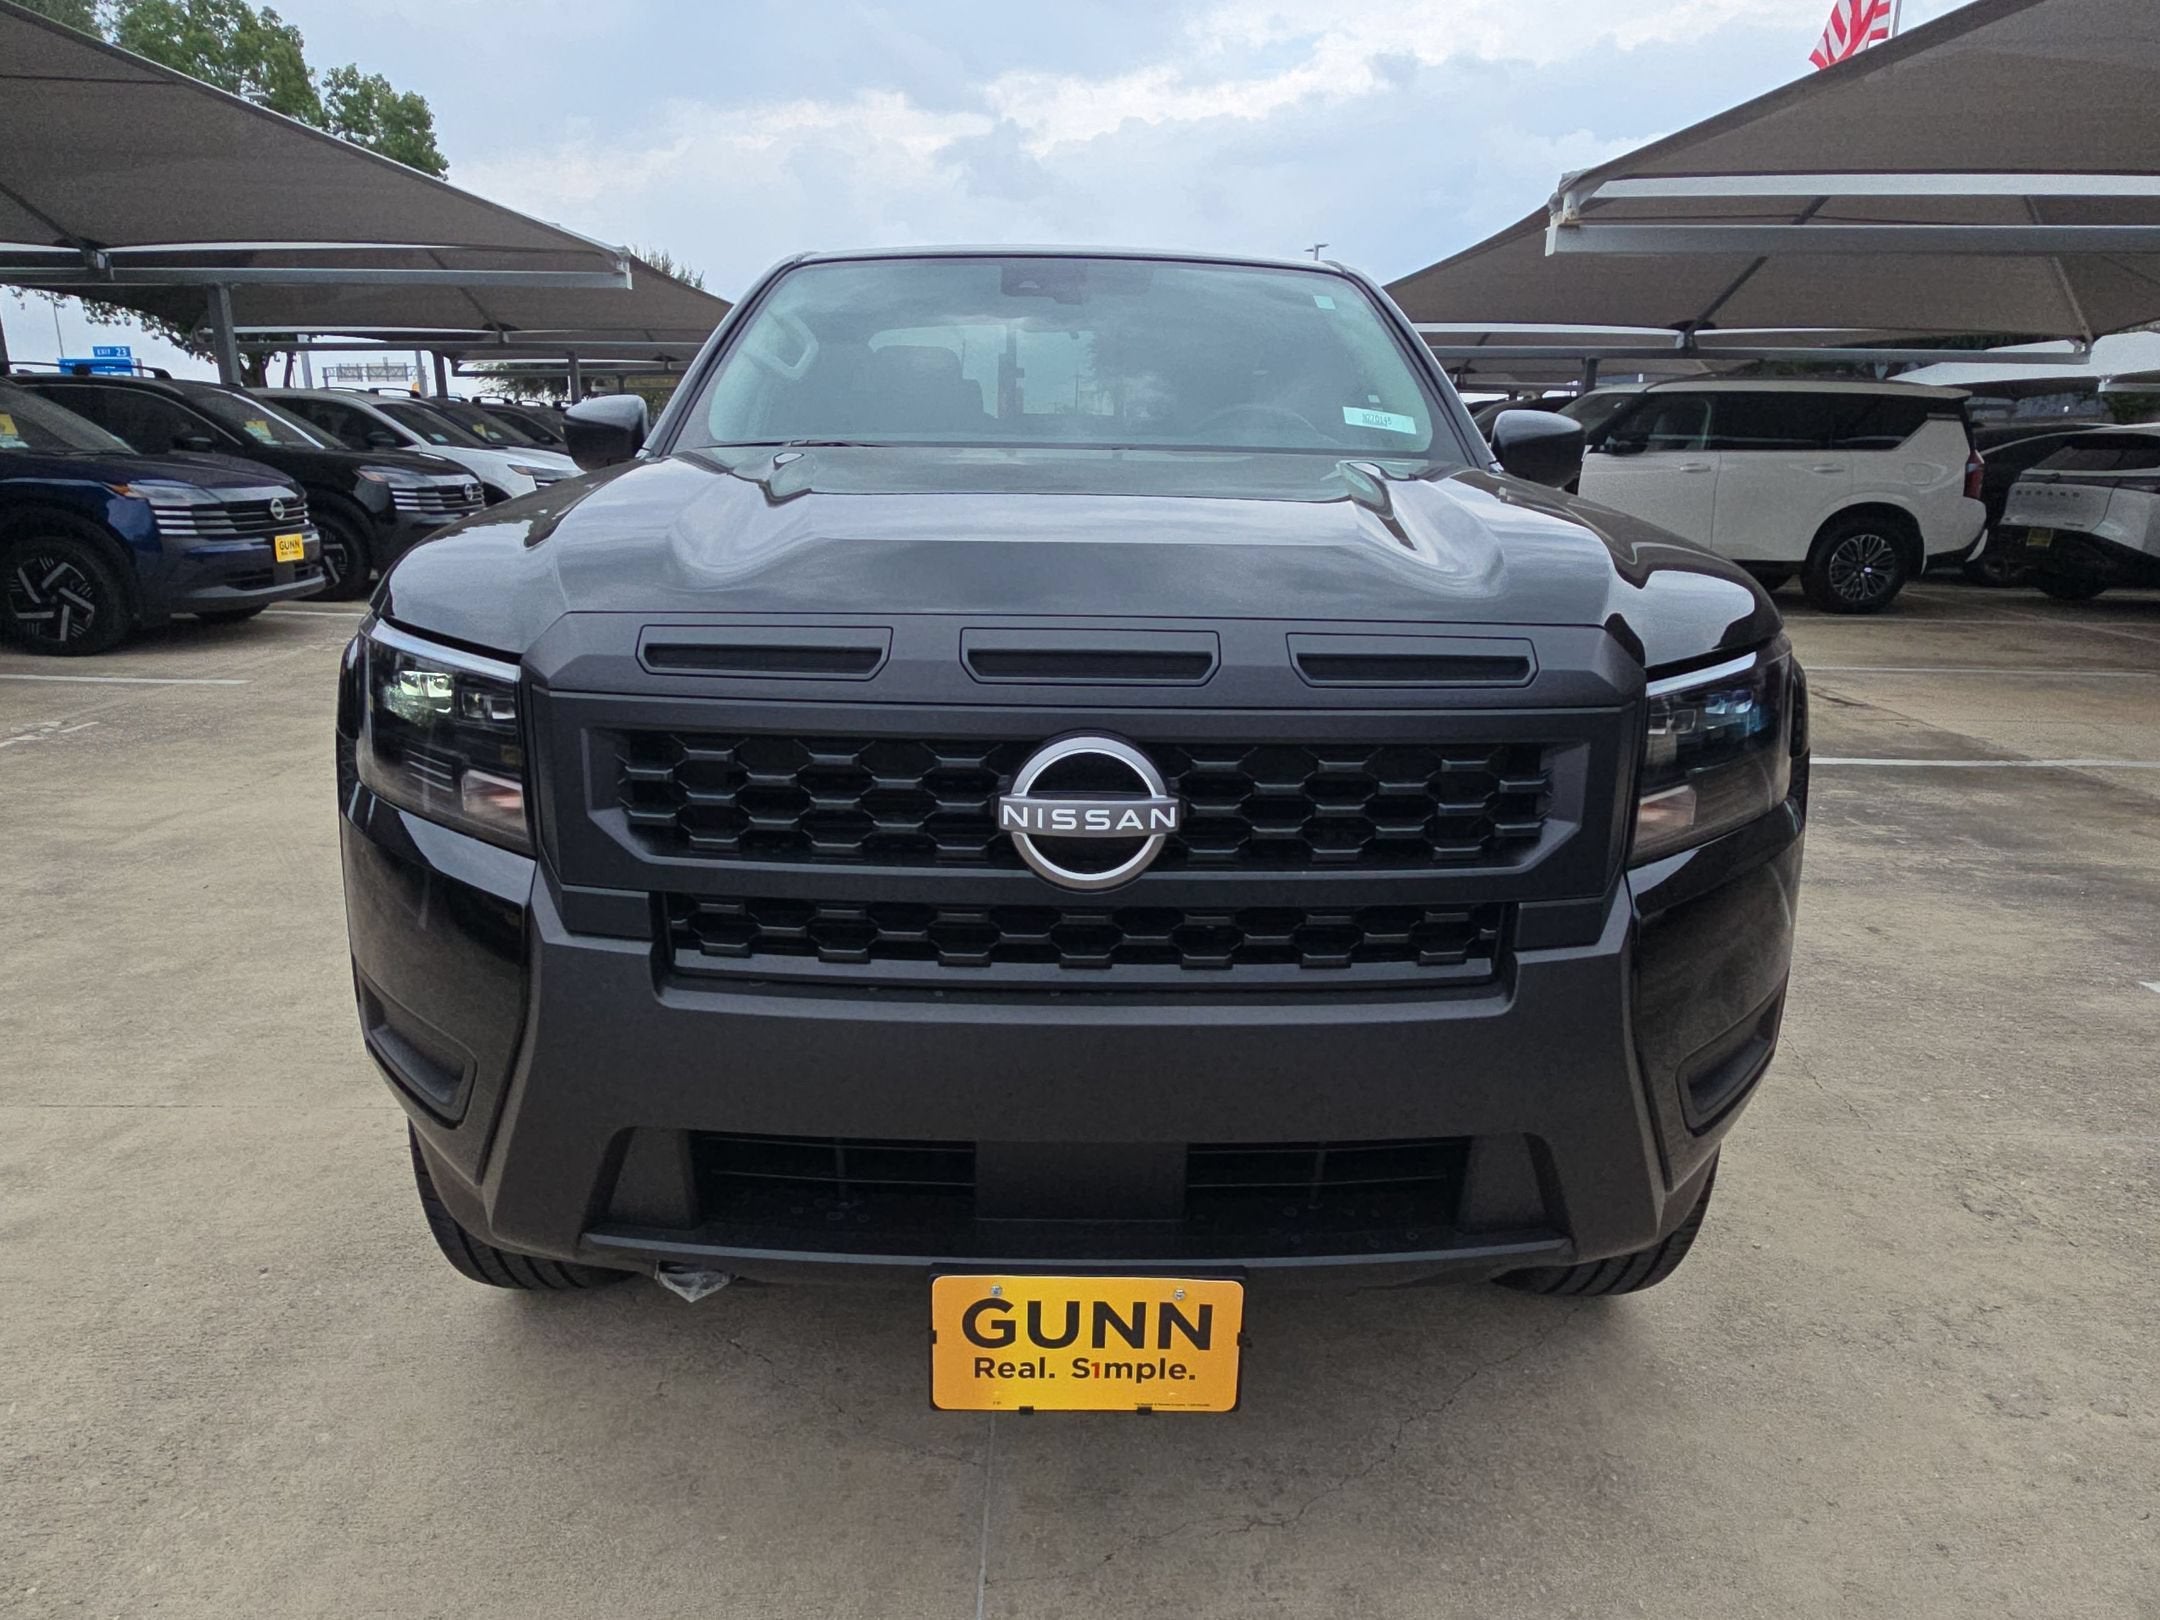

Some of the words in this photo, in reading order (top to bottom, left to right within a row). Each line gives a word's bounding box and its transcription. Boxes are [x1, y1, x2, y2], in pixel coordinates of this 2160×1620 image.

[115, 347, 128, 357] 23
[279, 539, 300, 551] GUNN
[1003, 805, 1176, 830] NISSAN
[961, 1297, 1214, 1351] GUNN
[974, 1357, 1056, 1379] Real.
